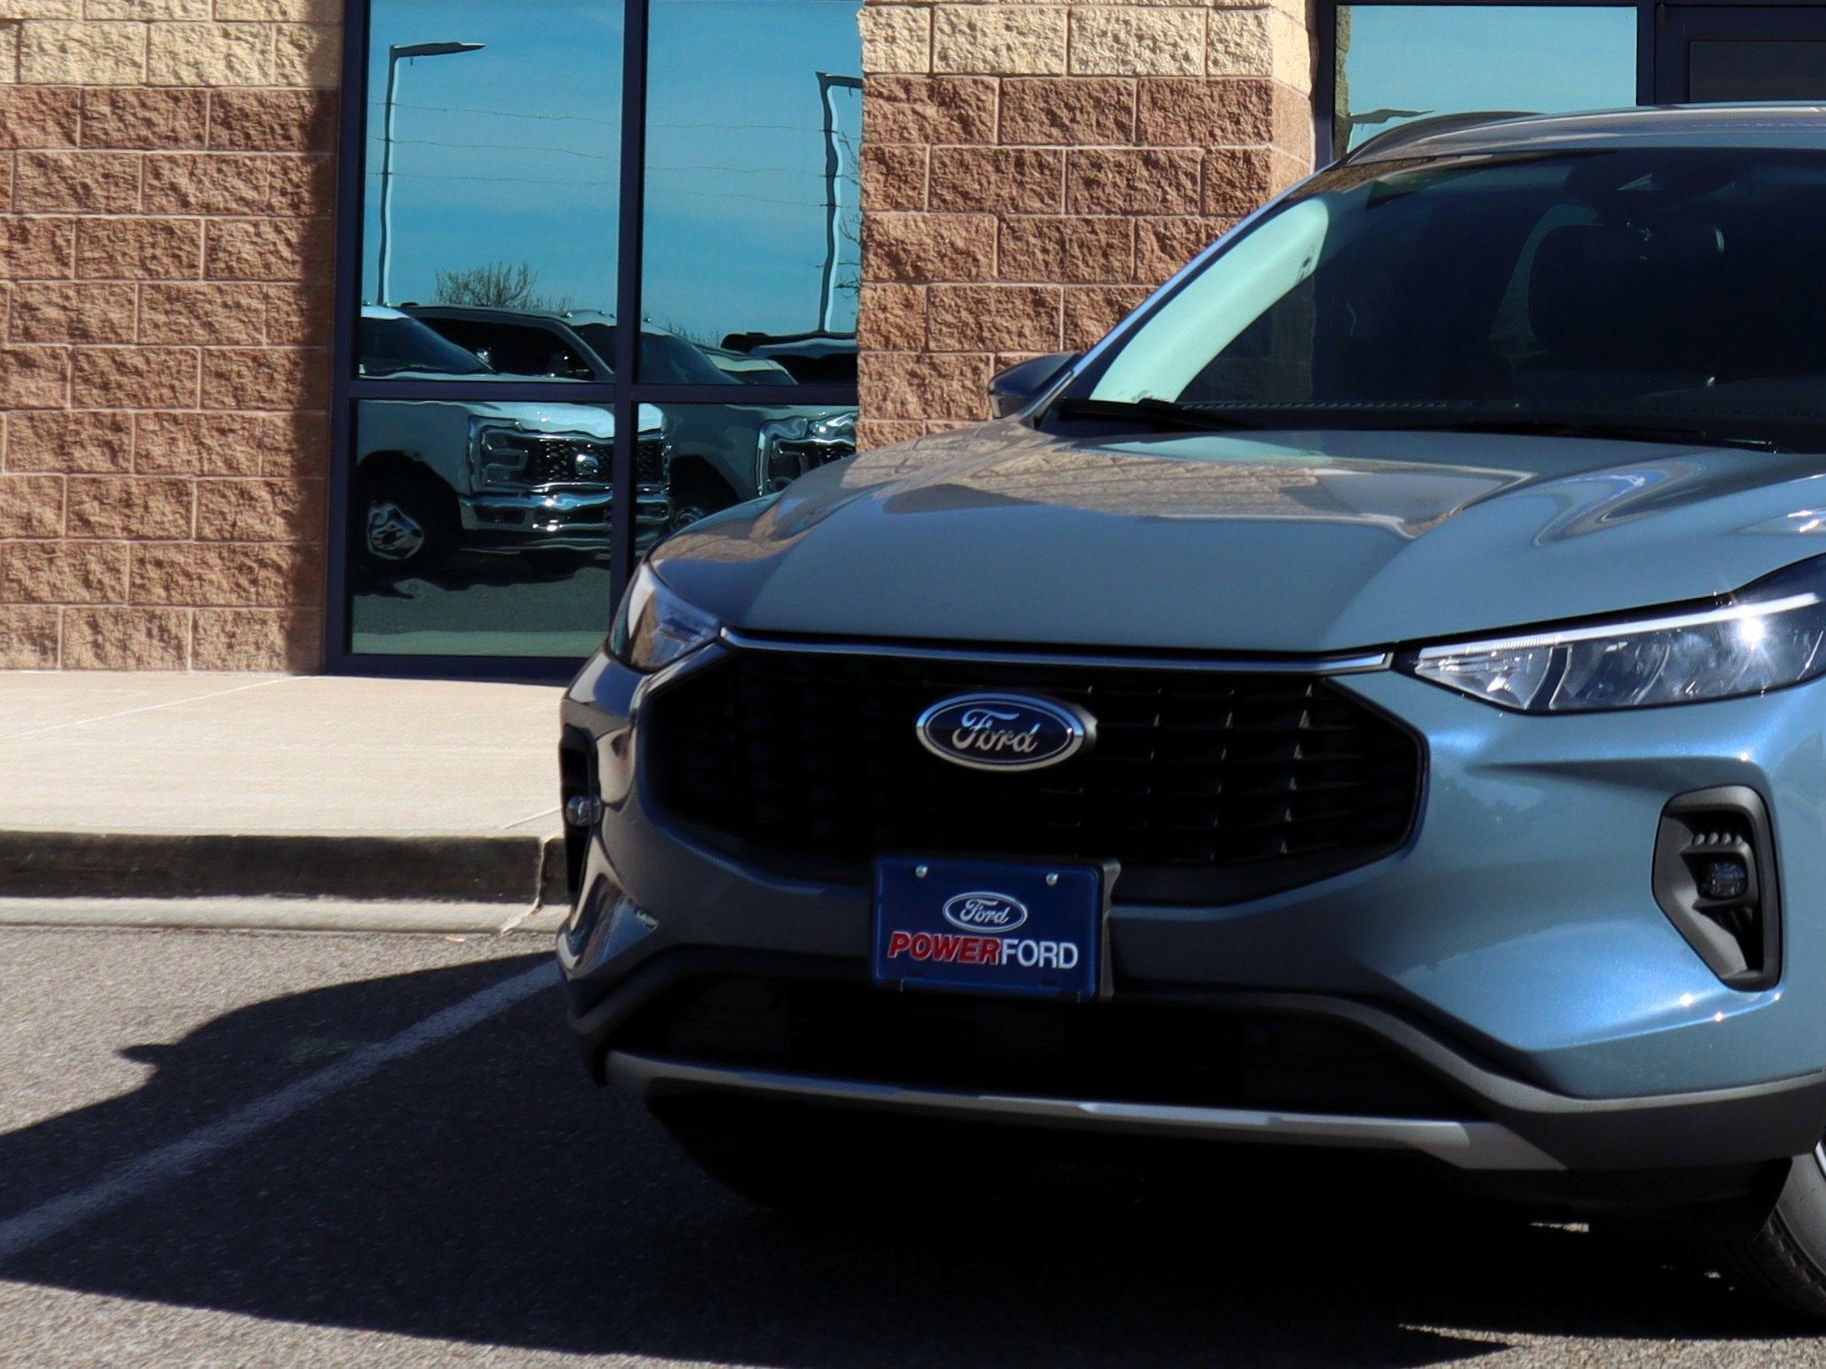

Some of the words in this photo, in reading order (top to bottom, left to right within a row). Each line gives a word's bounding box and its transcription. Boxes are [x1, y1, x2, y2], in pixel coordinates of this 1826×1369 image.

[952, 708, 1040, 753] Ford
[959, 898, 1009, 925] Ford
[887, 930, 1079, 969] POWERFORD
